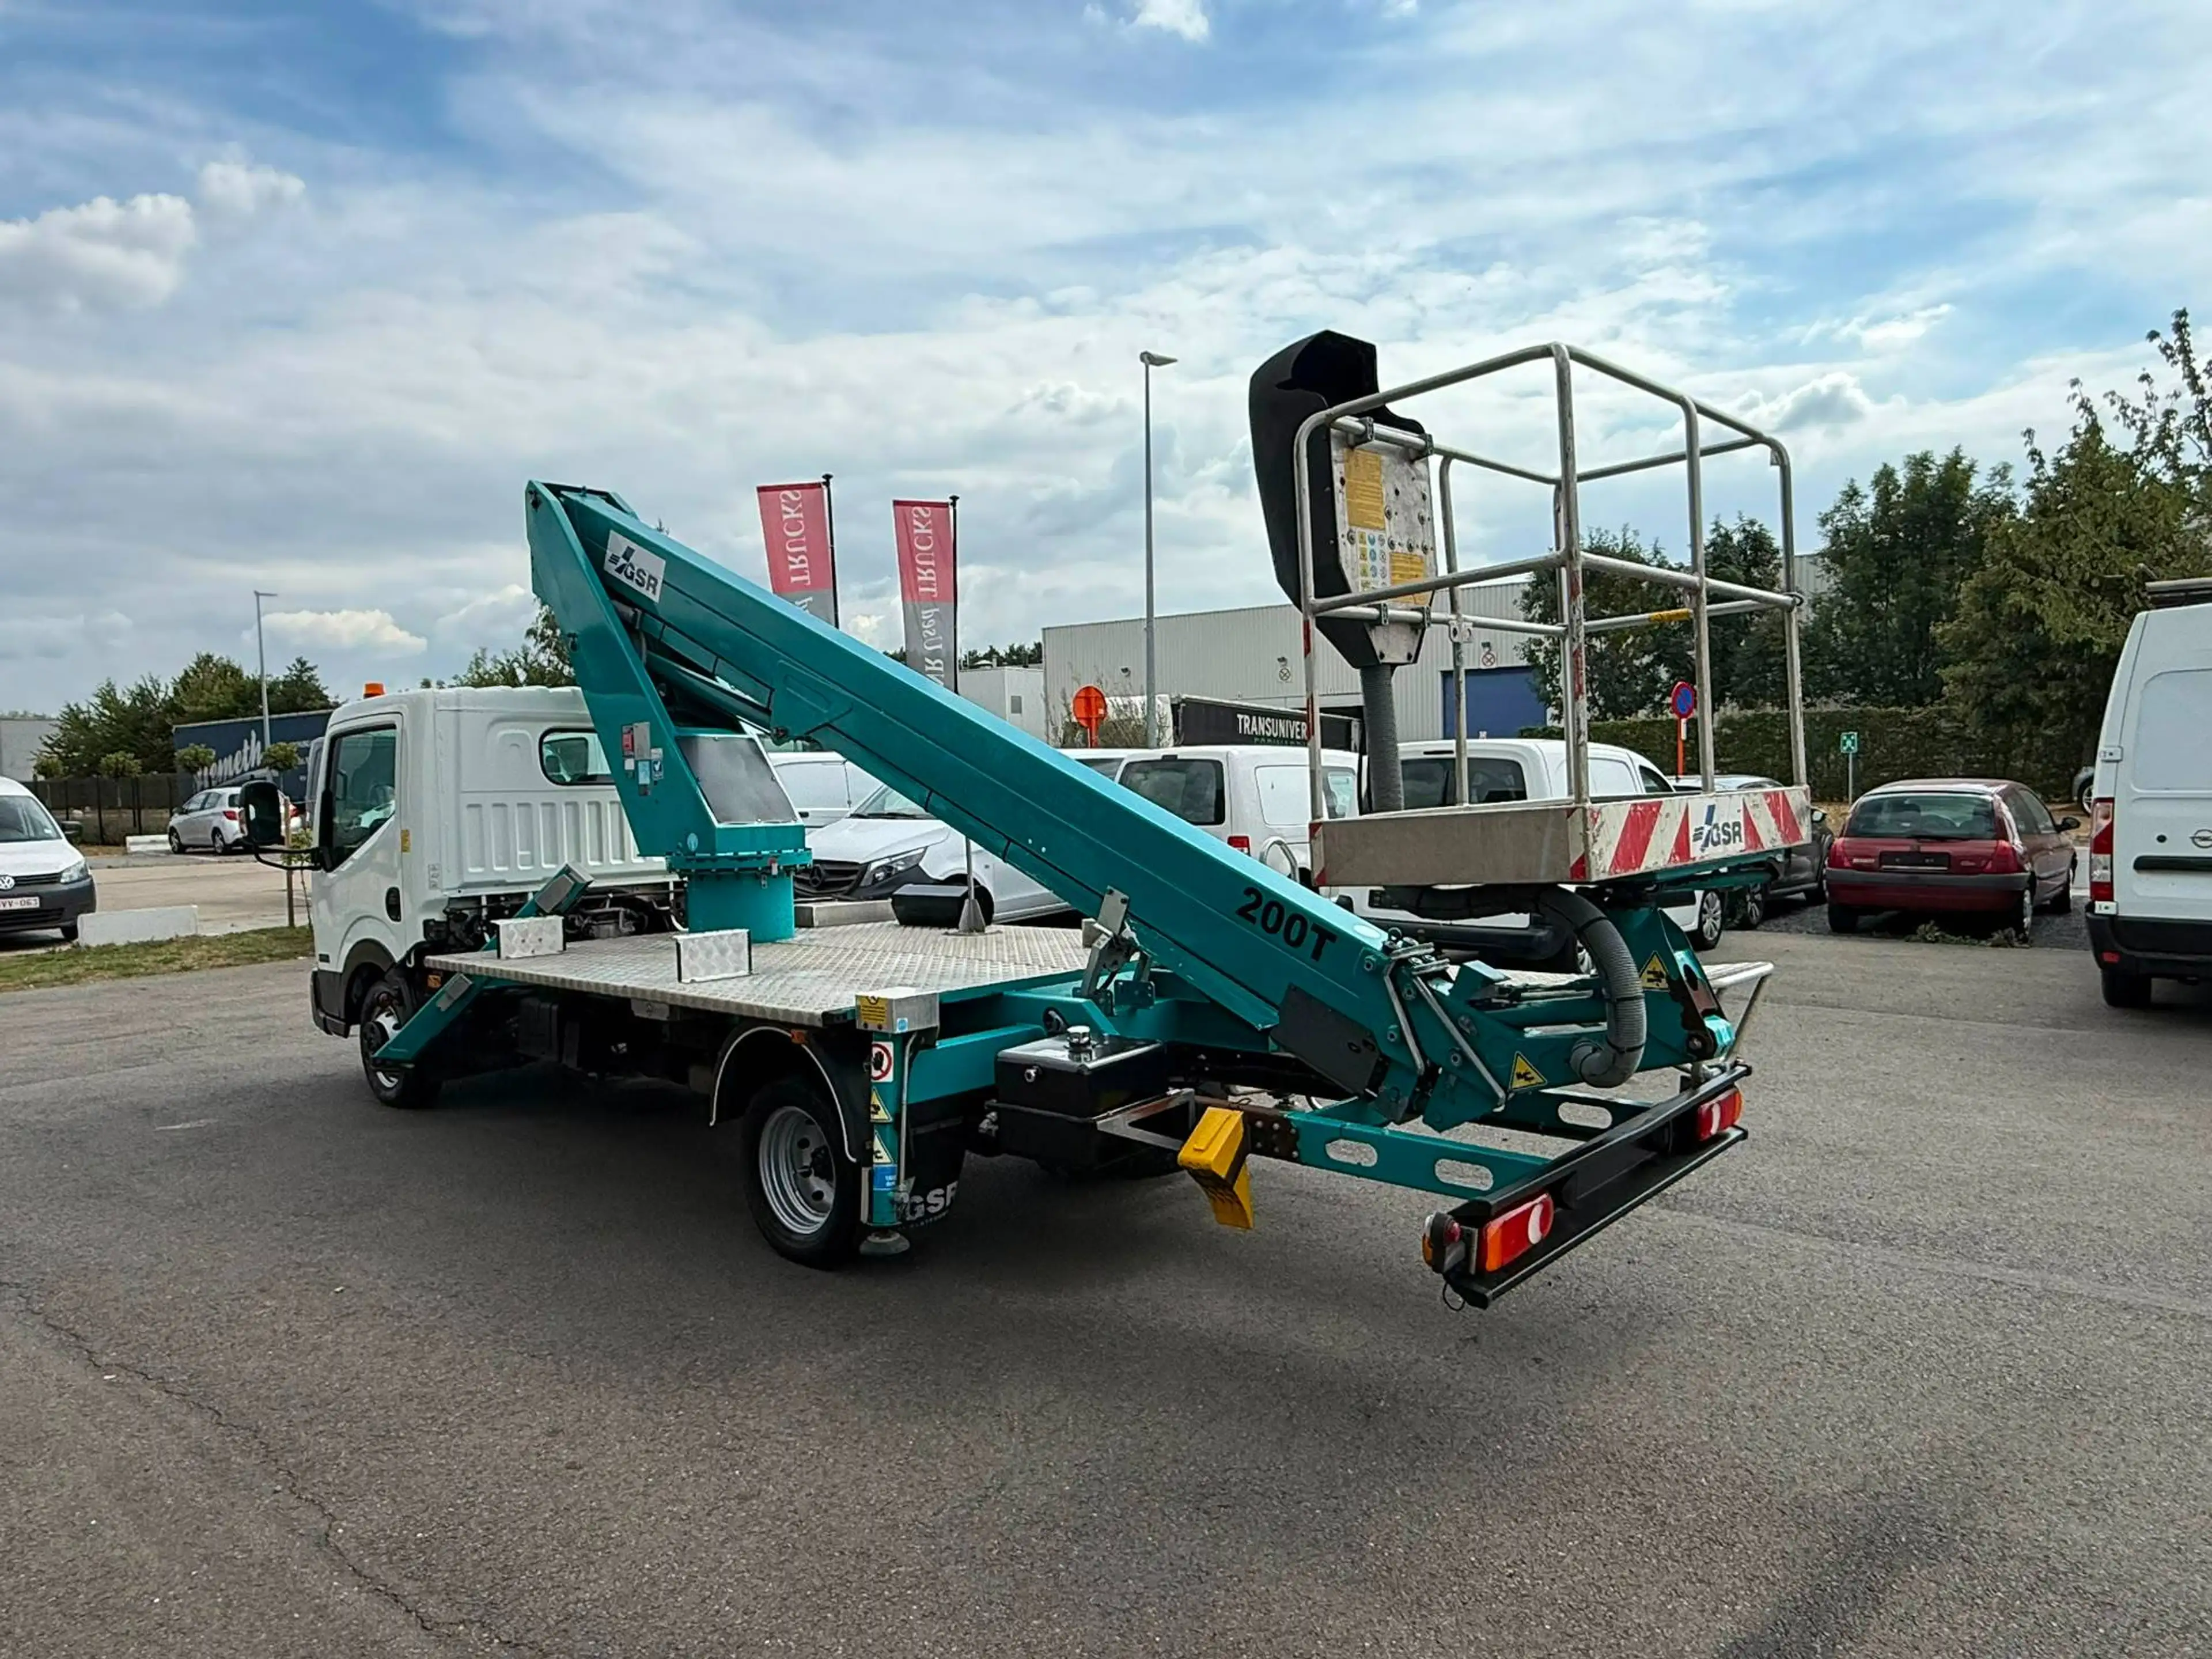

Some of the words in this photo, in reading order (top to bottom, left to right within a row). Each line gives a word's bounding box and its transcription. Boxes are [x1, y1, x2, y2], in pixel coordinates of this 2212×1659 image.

[623, 562, 658, 596] GSR
[1711, 820, 1742, 847] GSR
[1236, 887, 1338, 962] 200T
